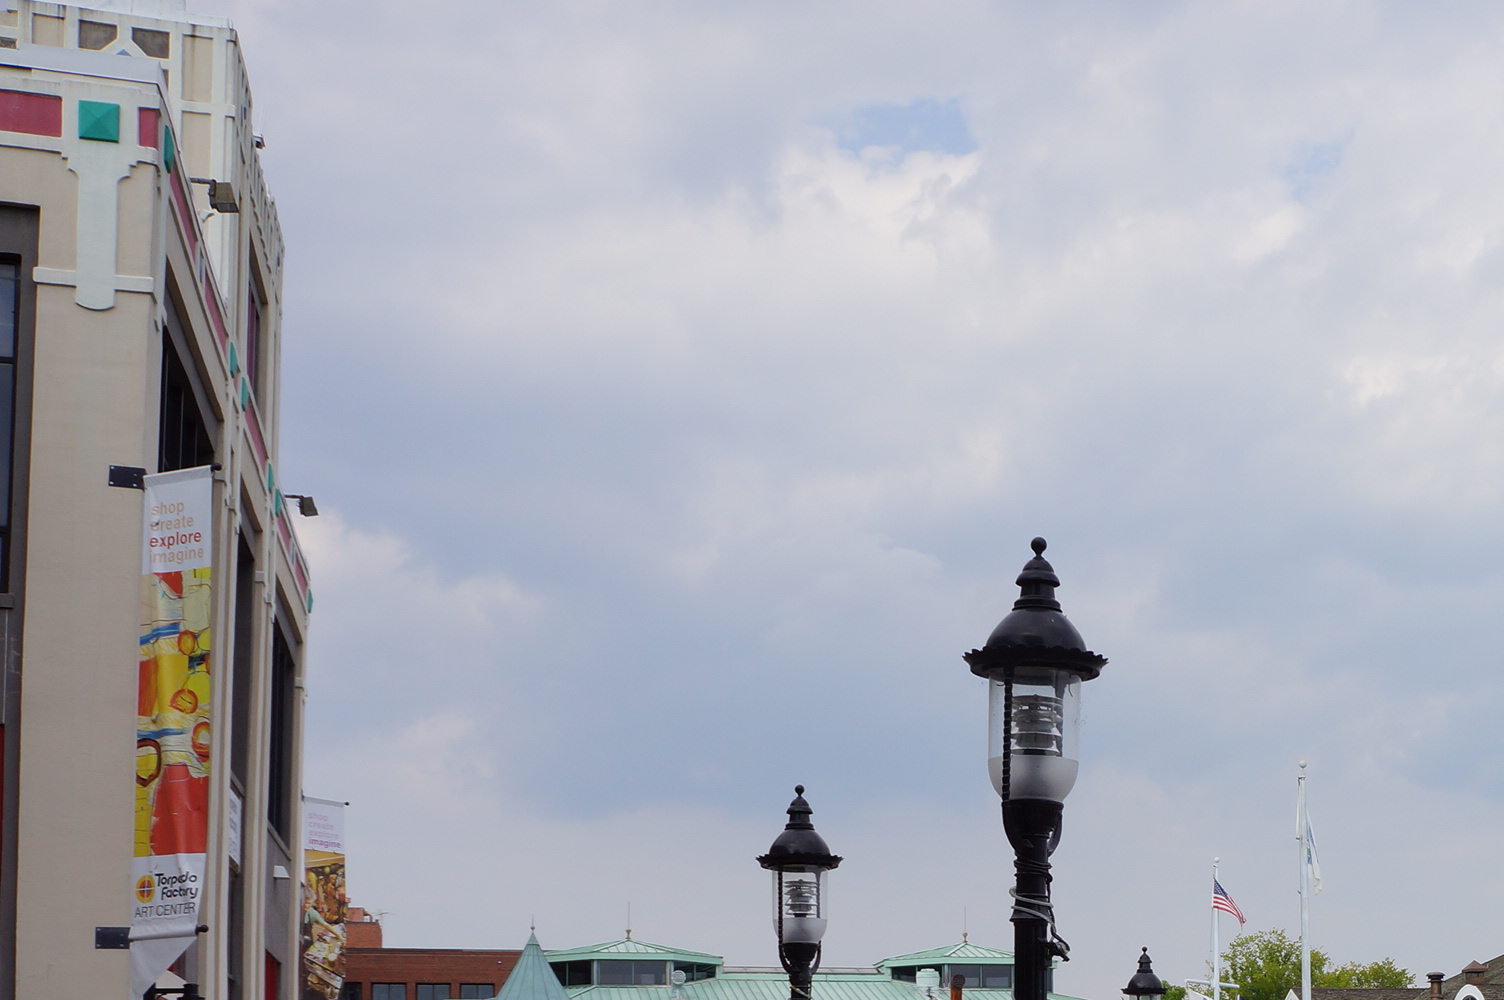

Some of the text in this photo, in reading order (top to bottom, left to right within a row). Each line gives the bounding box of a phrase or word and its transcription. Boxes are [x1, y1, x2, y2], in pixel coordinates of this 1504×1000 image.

[151, 501, 184, 516] shop
[150, 515, 194, 532] create
[149, 531, 202, 549] explore
[149, 546, 204, 565] imagine
[308, 838, 341, 849] imagine
[154, 871, 198, 888] Torpedo
[134, 901, 196, 918] ART CENTER
